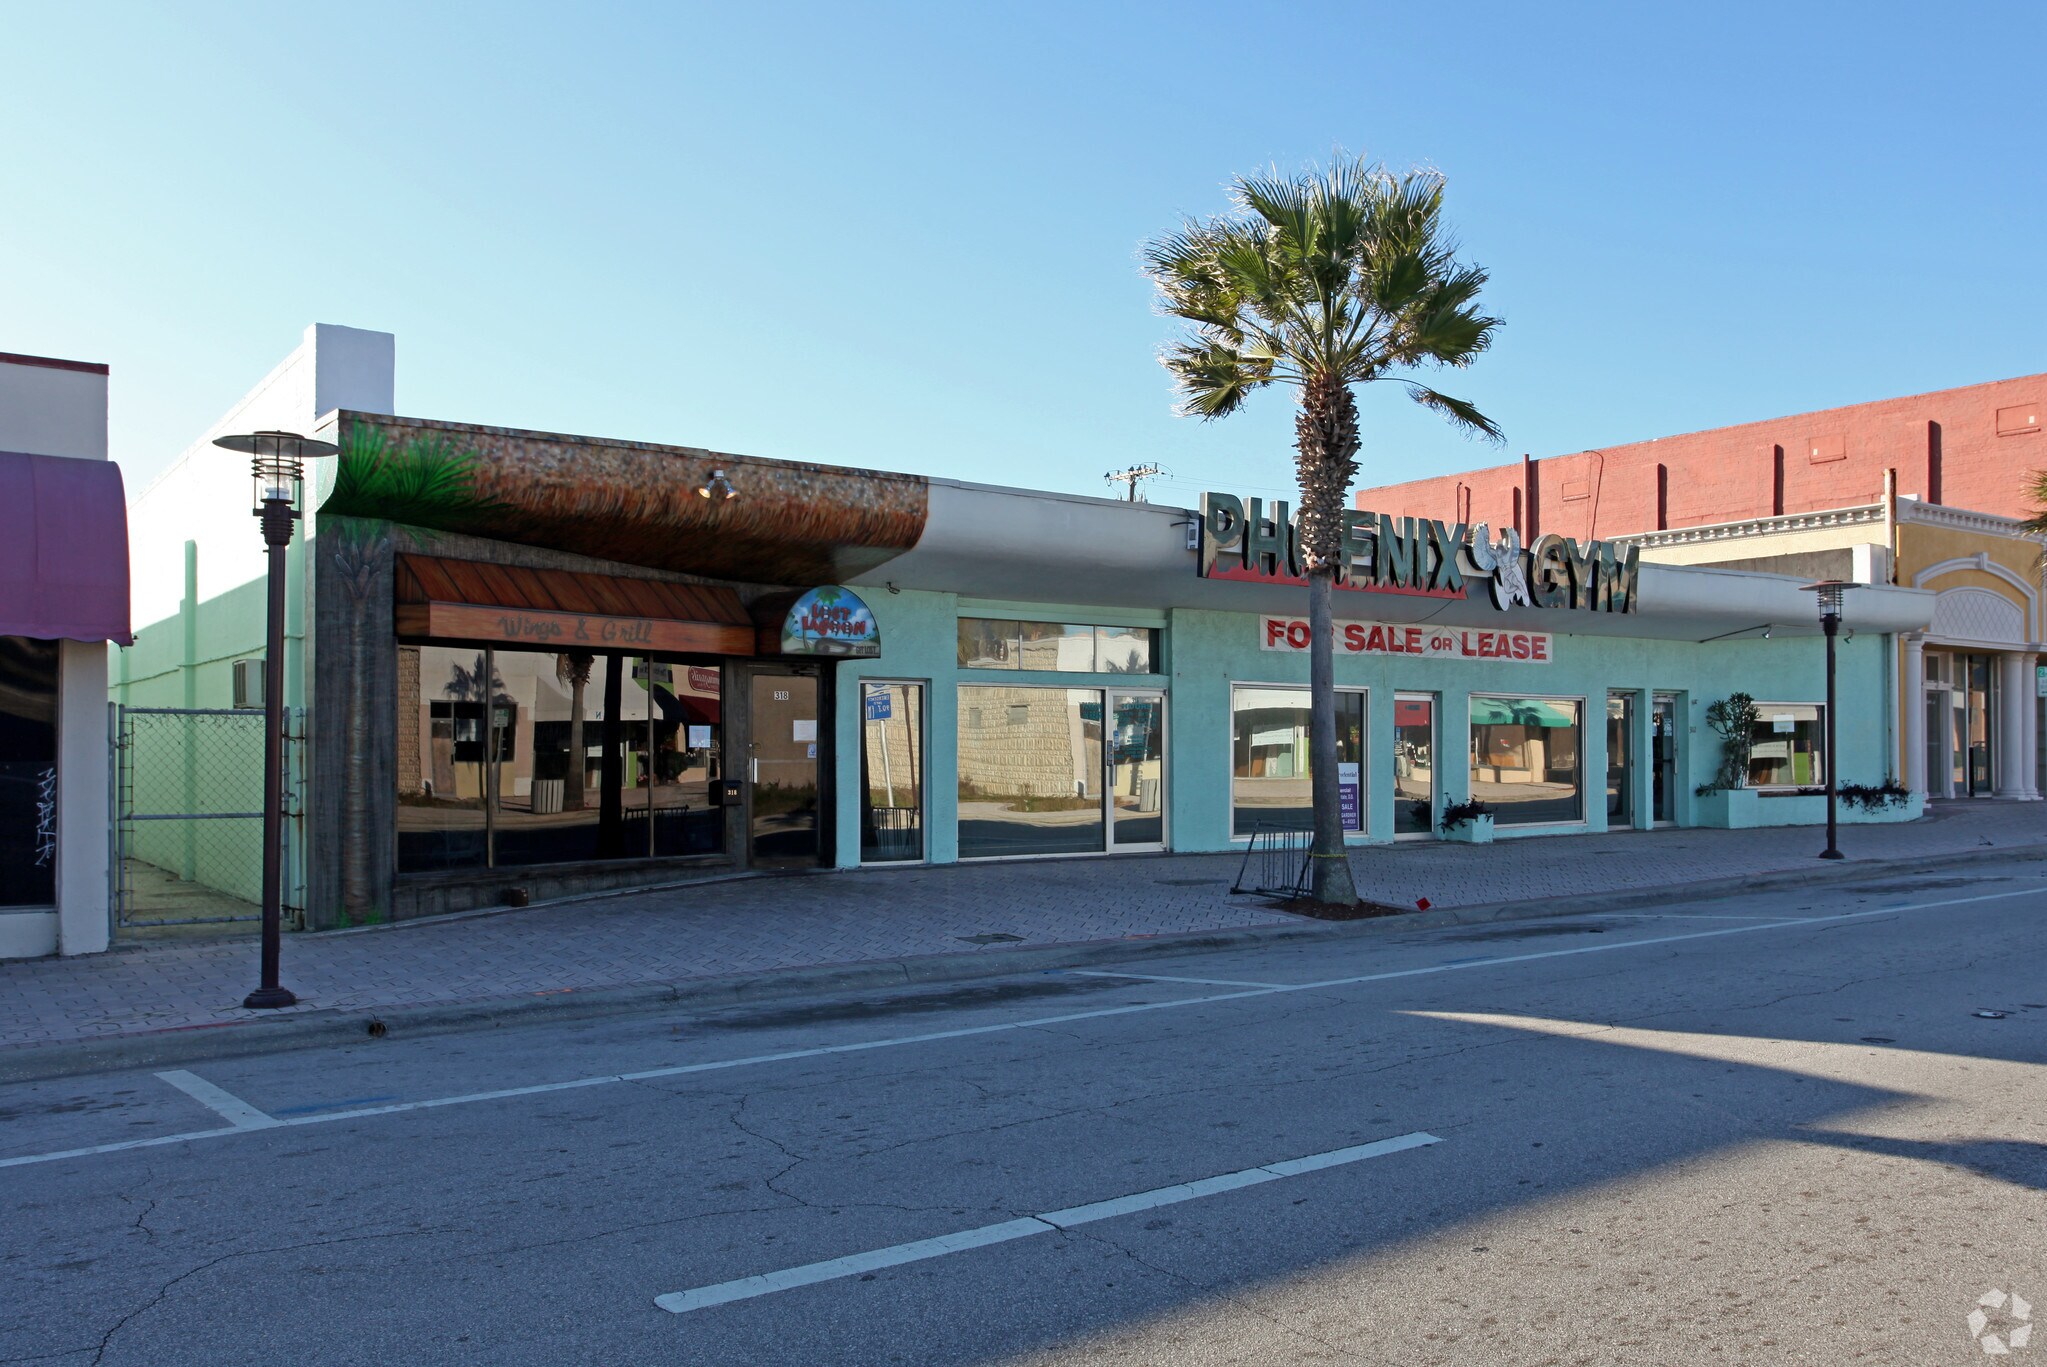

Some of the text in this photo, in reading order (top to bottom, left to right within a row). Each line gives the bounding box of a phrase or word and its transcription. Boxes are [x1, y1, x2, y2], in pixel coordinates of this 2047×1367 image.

[1198, 491, 1640, 614] PHENIX GYM
[812, 604, 851, 620] LOST
[498, 615, 654, 643] Wings & Grill
[802, 616, 866, 637] LAGOON
[1267, 619, 1548, 660] FO SALE OR LEASE
[775, 691, 788, 700] 318
